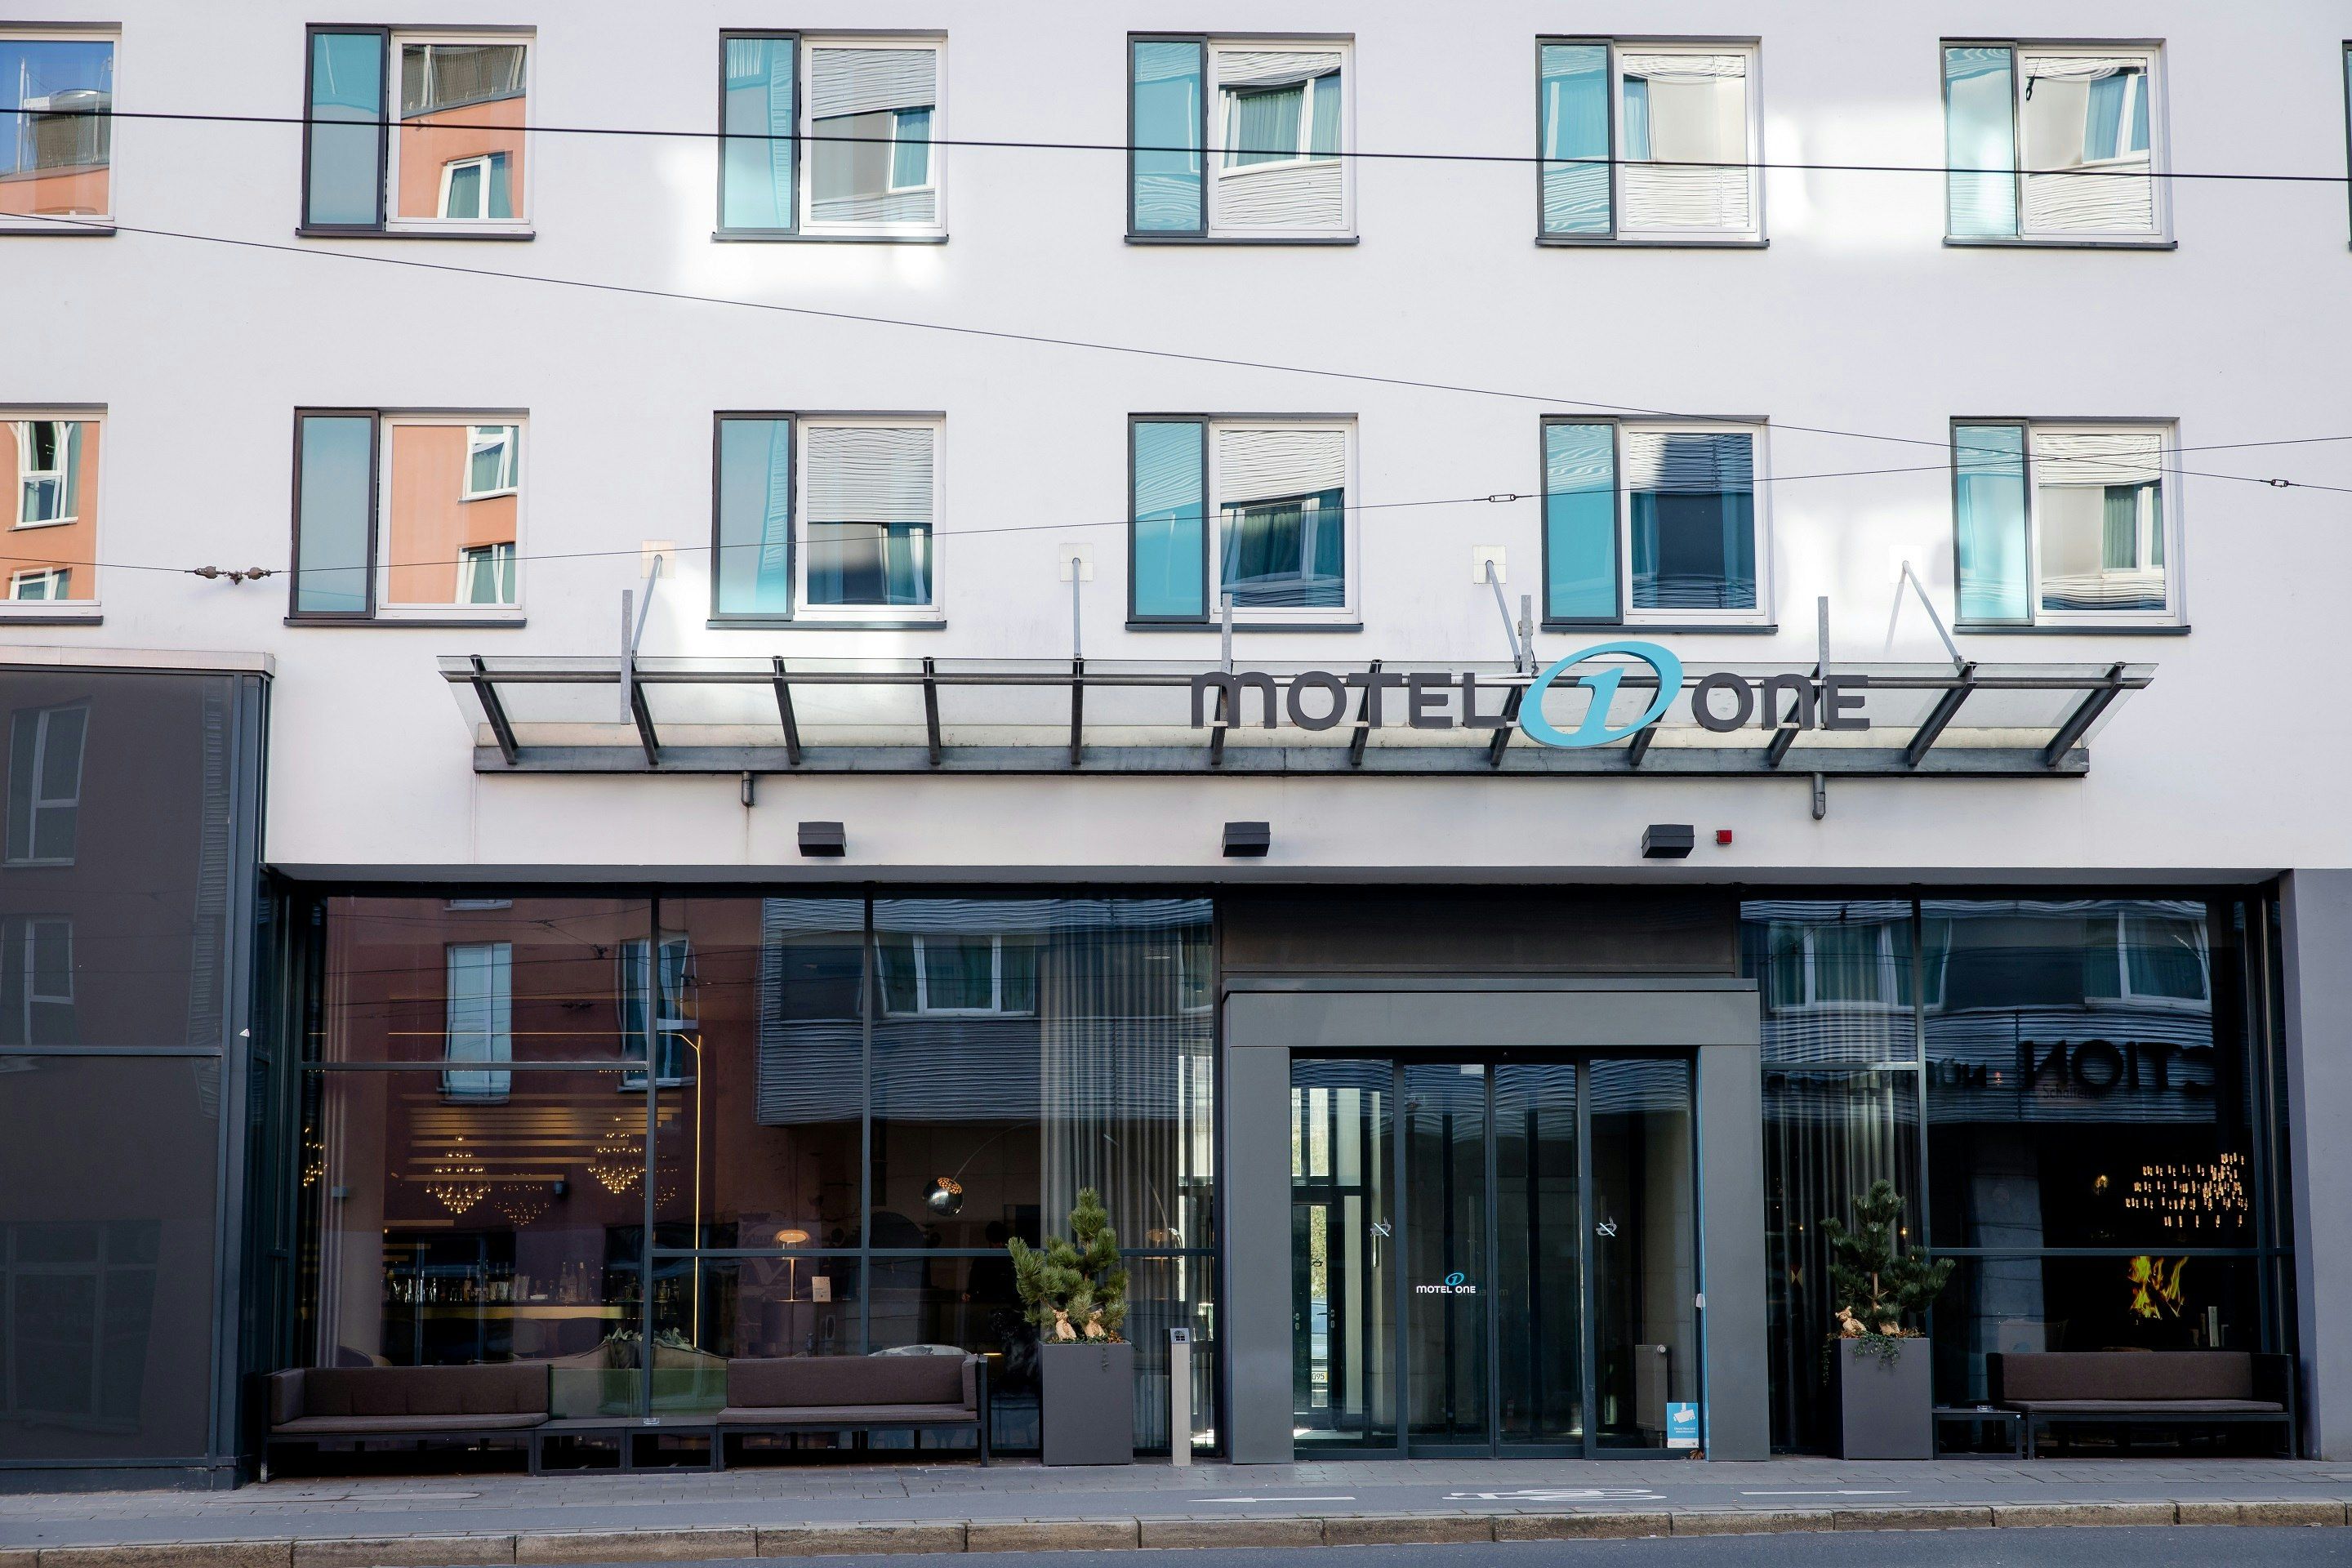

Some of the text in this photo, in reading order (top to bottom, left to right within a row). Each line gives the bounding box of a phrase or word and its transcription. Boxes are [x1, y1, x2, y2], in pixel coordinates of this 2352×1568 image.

[1191, 670, 1508, 729] MOTEL
[1691, 671, 1870, 732] ONE
[1455, 1285, 1476, 1294] ONE
